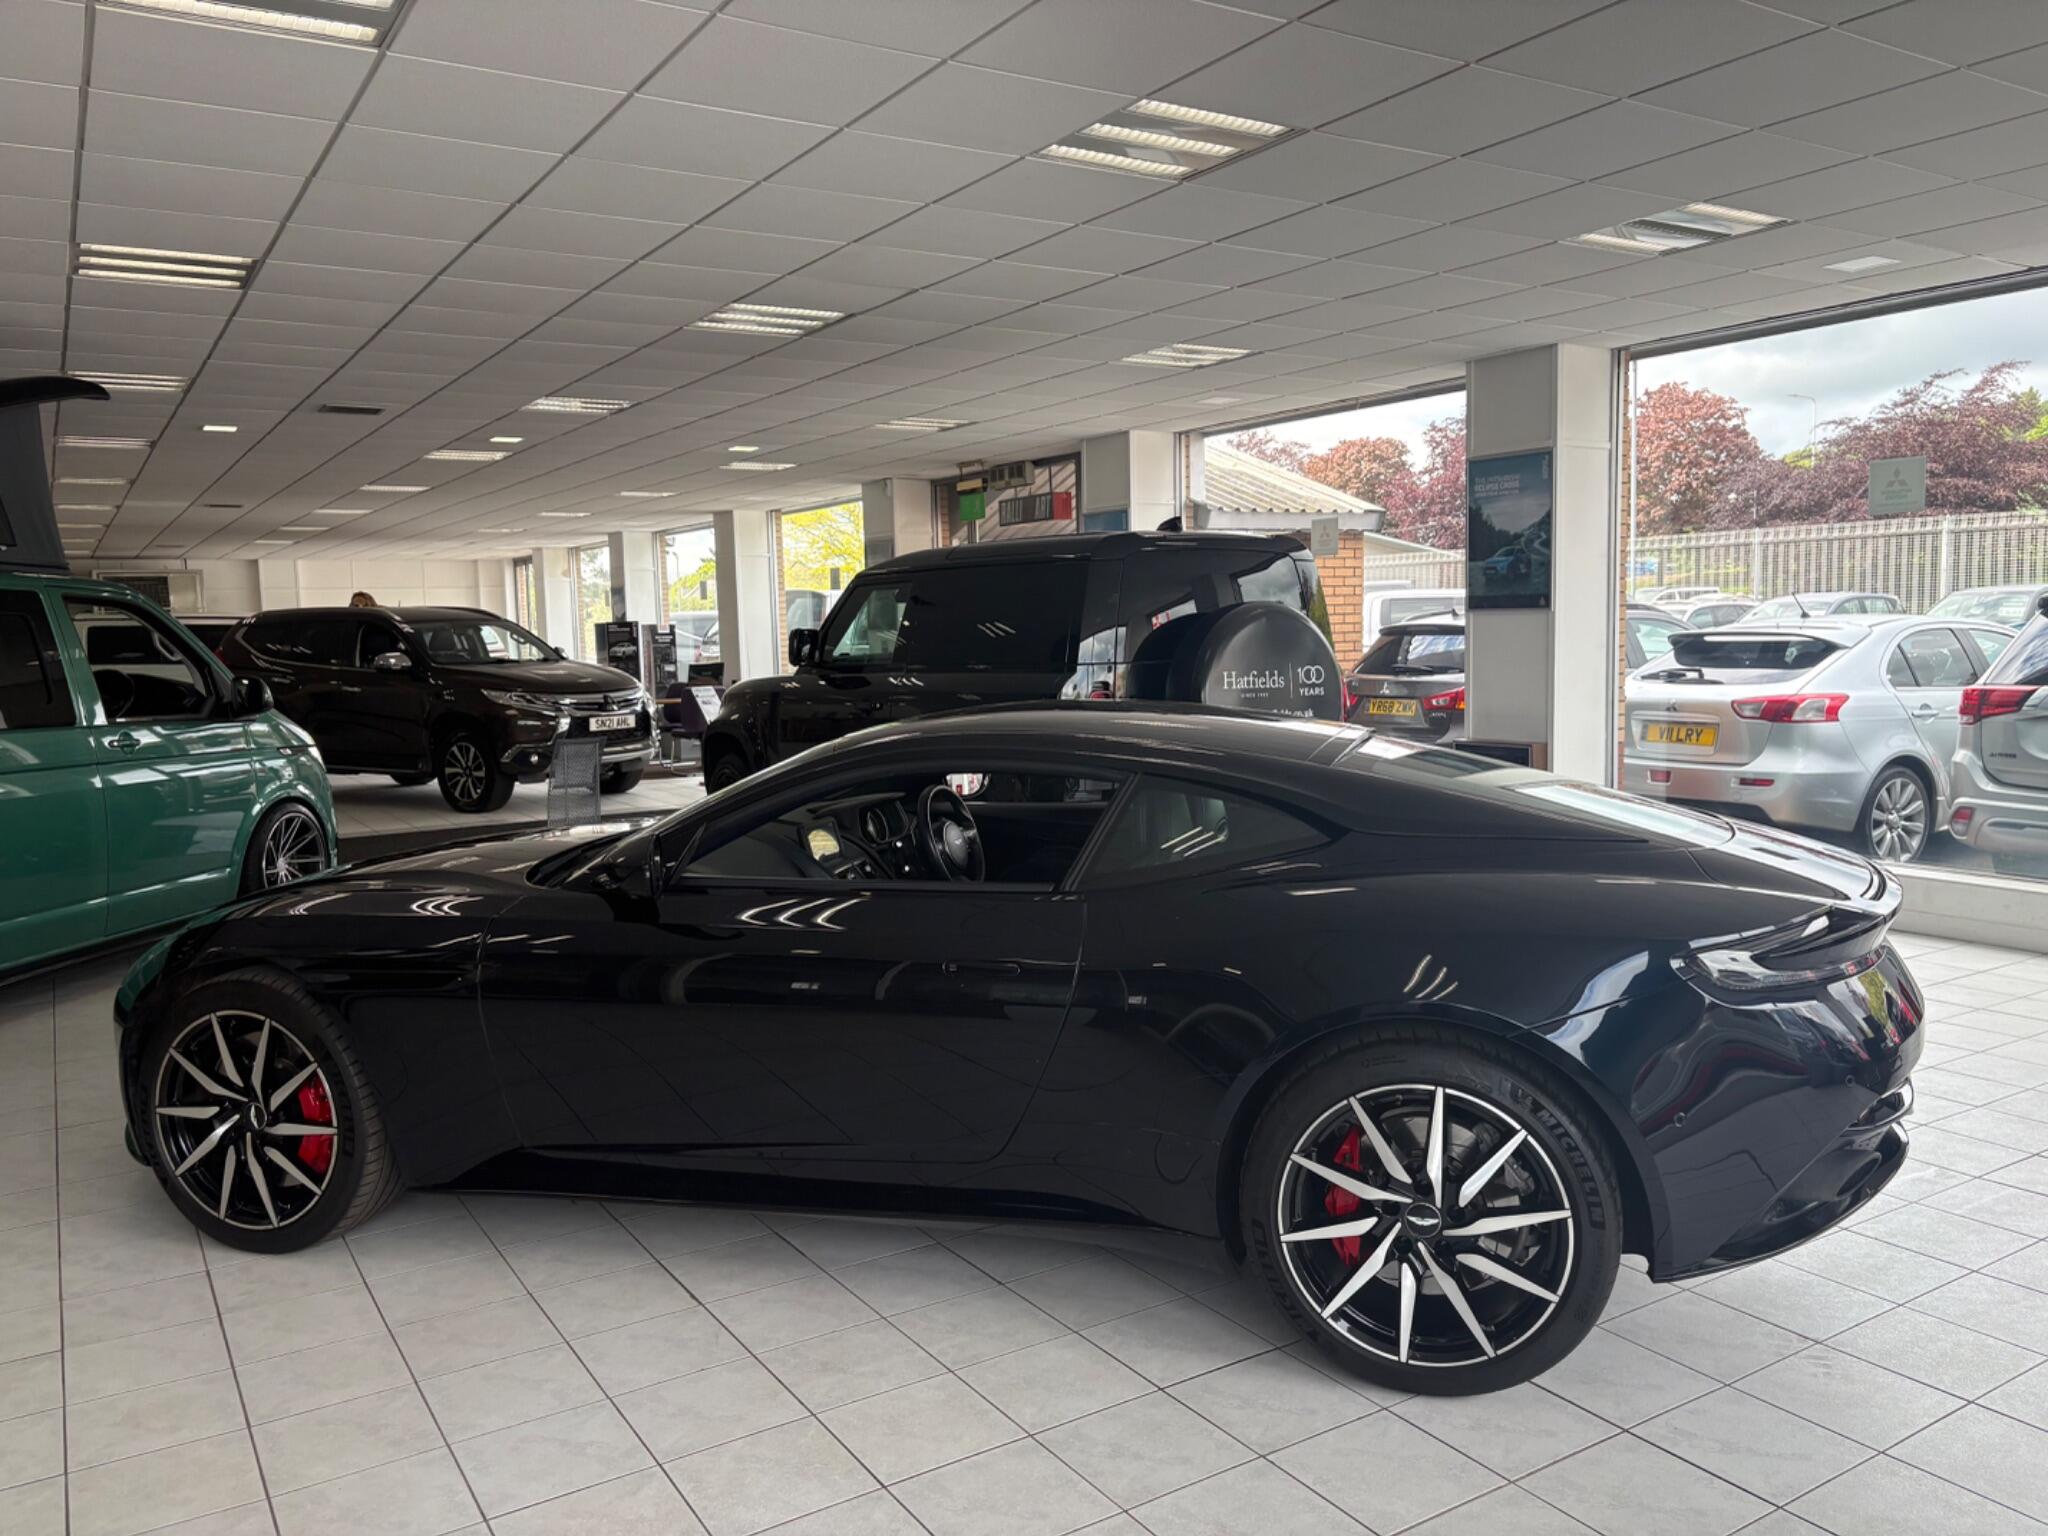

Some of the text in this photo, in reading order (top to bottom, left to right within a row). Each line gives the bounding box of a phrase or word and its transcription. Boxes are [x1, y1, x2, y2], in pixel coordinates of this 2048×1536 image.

[1222, 670, 1285, 690] Hatfields
[1298, 664, 1325, 684] 100
[1299, 686, 1325, 697] YEARS
[1371, 698, 1394, 713] YR68
[594, 718, 614, 729] SN21
[1536, 1109, 1605, 1223] MICHELIN
